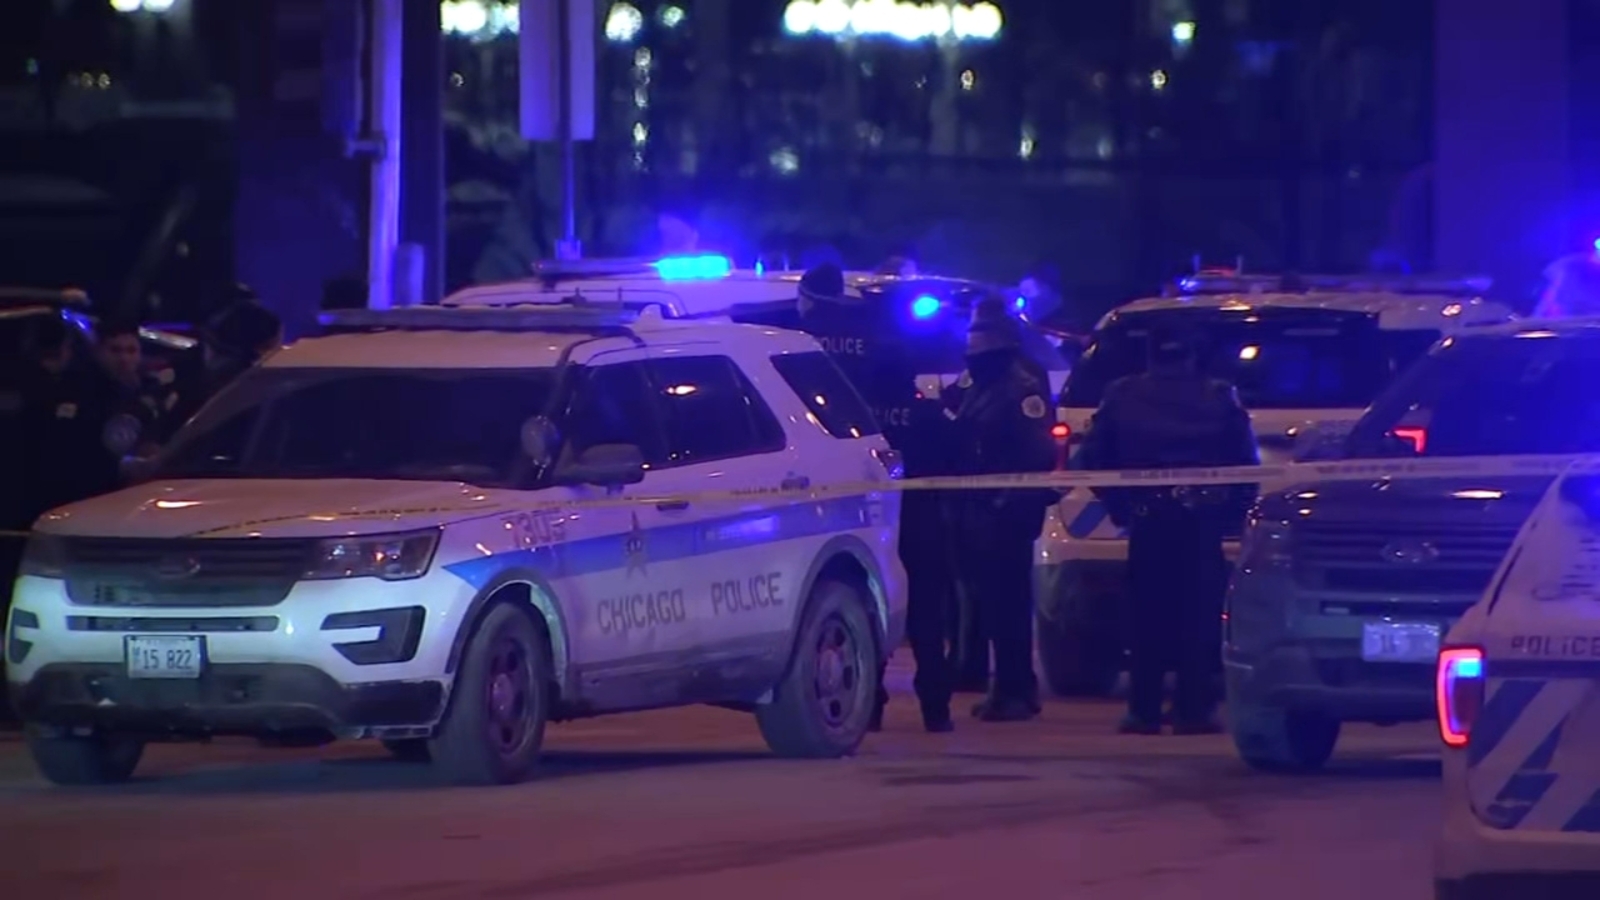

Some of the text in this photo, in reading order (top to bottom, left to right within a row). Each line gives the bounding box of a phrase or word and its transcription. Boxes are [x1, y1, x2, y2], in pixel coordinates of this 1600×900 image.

[818, 337, 865, 354] OLICE
[597, 572, 784, 636] CHICAGO POLICE
[167, 649, 193, 670] 822
